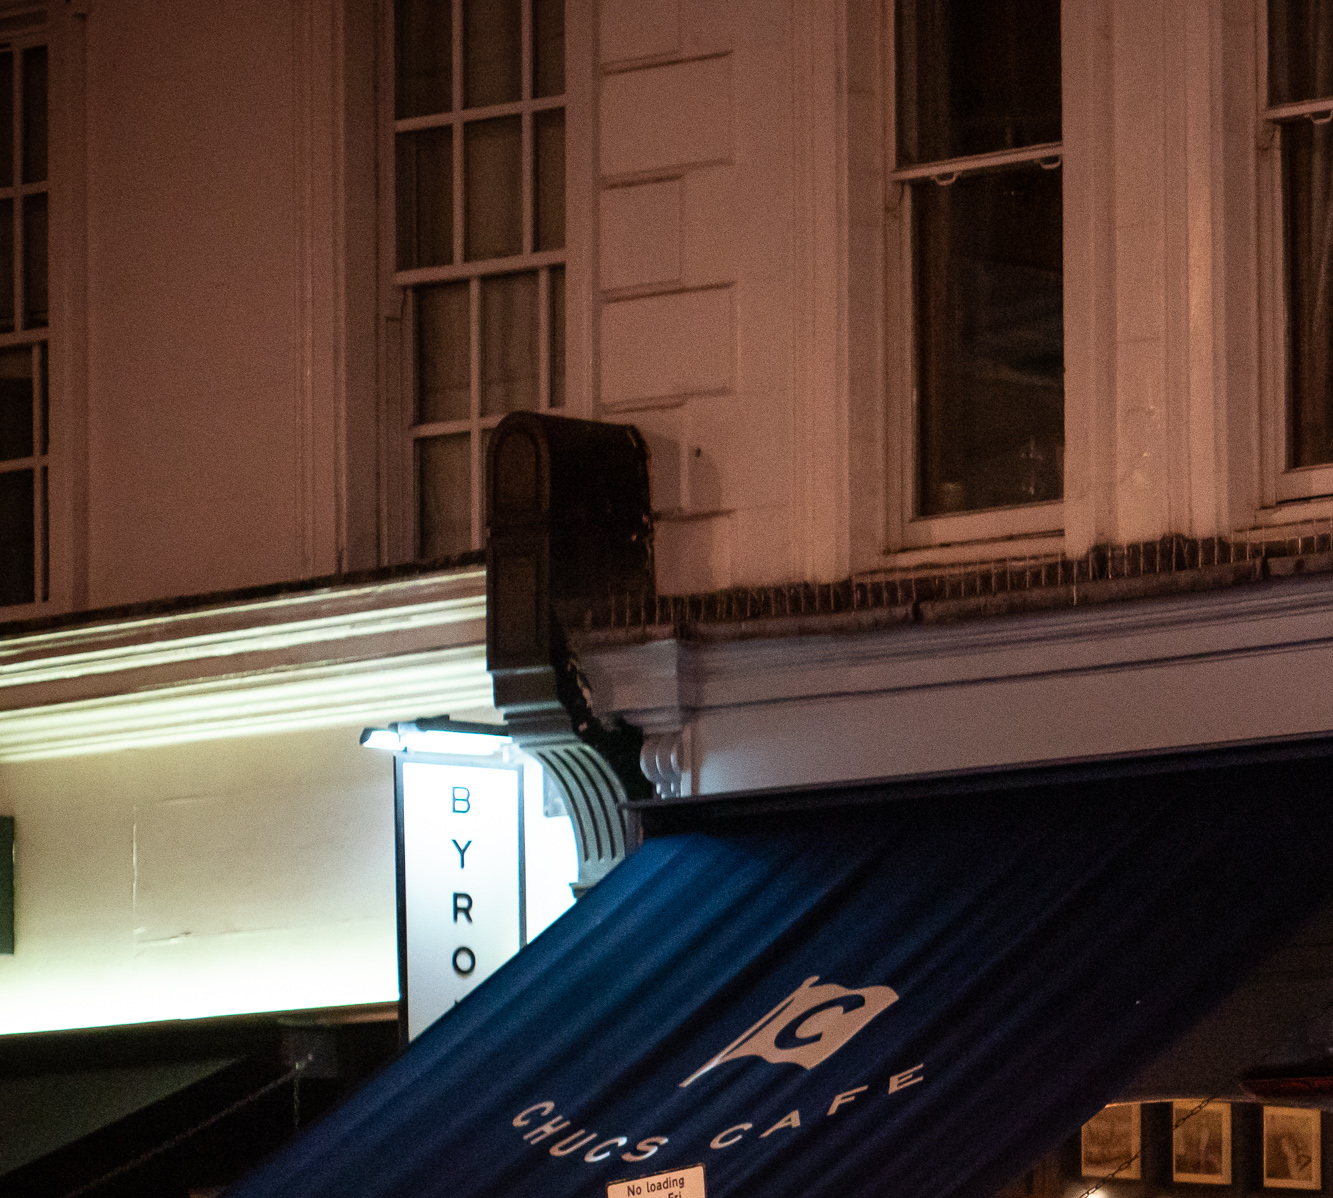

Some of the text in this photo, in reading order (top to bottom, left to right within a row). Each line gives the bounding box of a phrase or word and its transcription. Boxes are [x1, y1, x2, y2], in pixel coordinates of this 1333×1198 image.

[451, 786, 476, 1003] BYRO
[774, 994, 866, 1051] C
[512, 1063, 923, 1162] CHUCS CAFE
[626, 1177, 684, 1197] No loading
